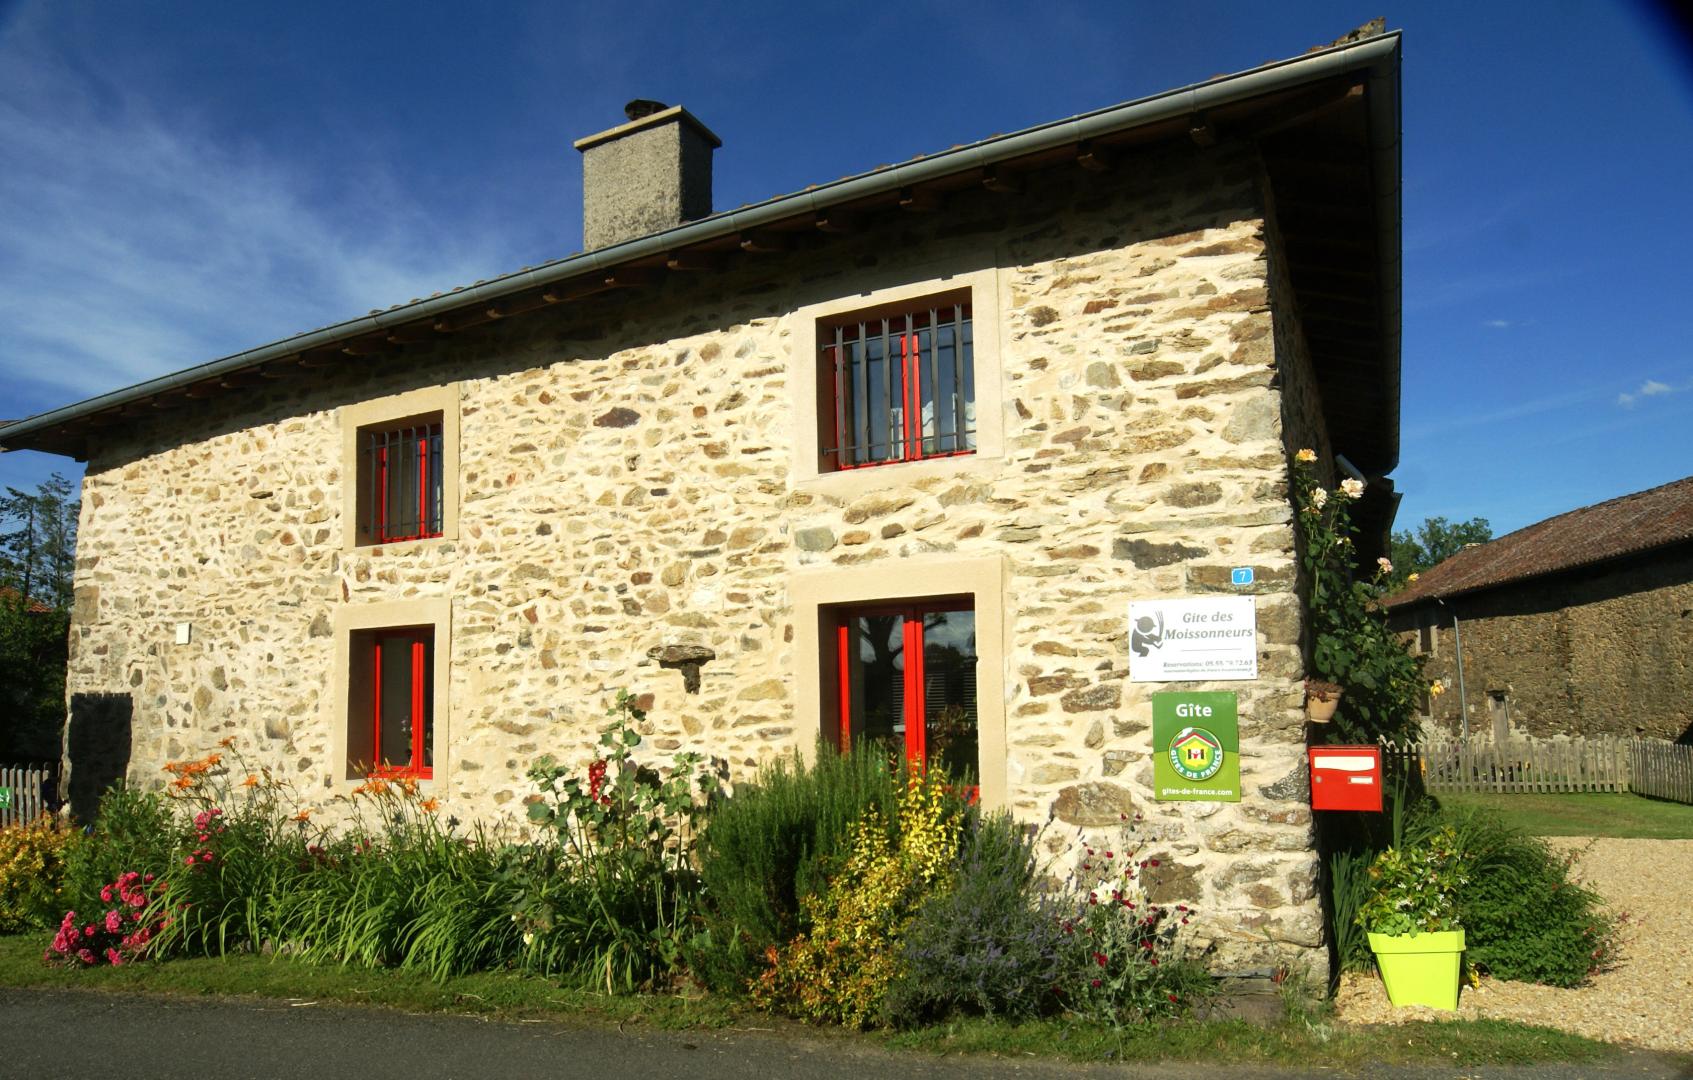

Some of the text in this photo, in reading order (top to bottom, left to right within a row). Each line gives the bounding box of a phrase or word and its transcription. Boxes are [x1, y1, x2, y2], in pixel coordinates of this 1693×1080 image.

[1240, 570, 1246, 582] 7
[1182, 611, 1233, 624] Gite des
[1164, 627, 1253, 640] Moissonneurs
[1176, 703, 1212, 717] Gîte
[1186, 771, 1198, 779] DE
[1200, 749, 1221, 778] FRANCE
[1162, 788, 1233, 796] gites-de-france.com
